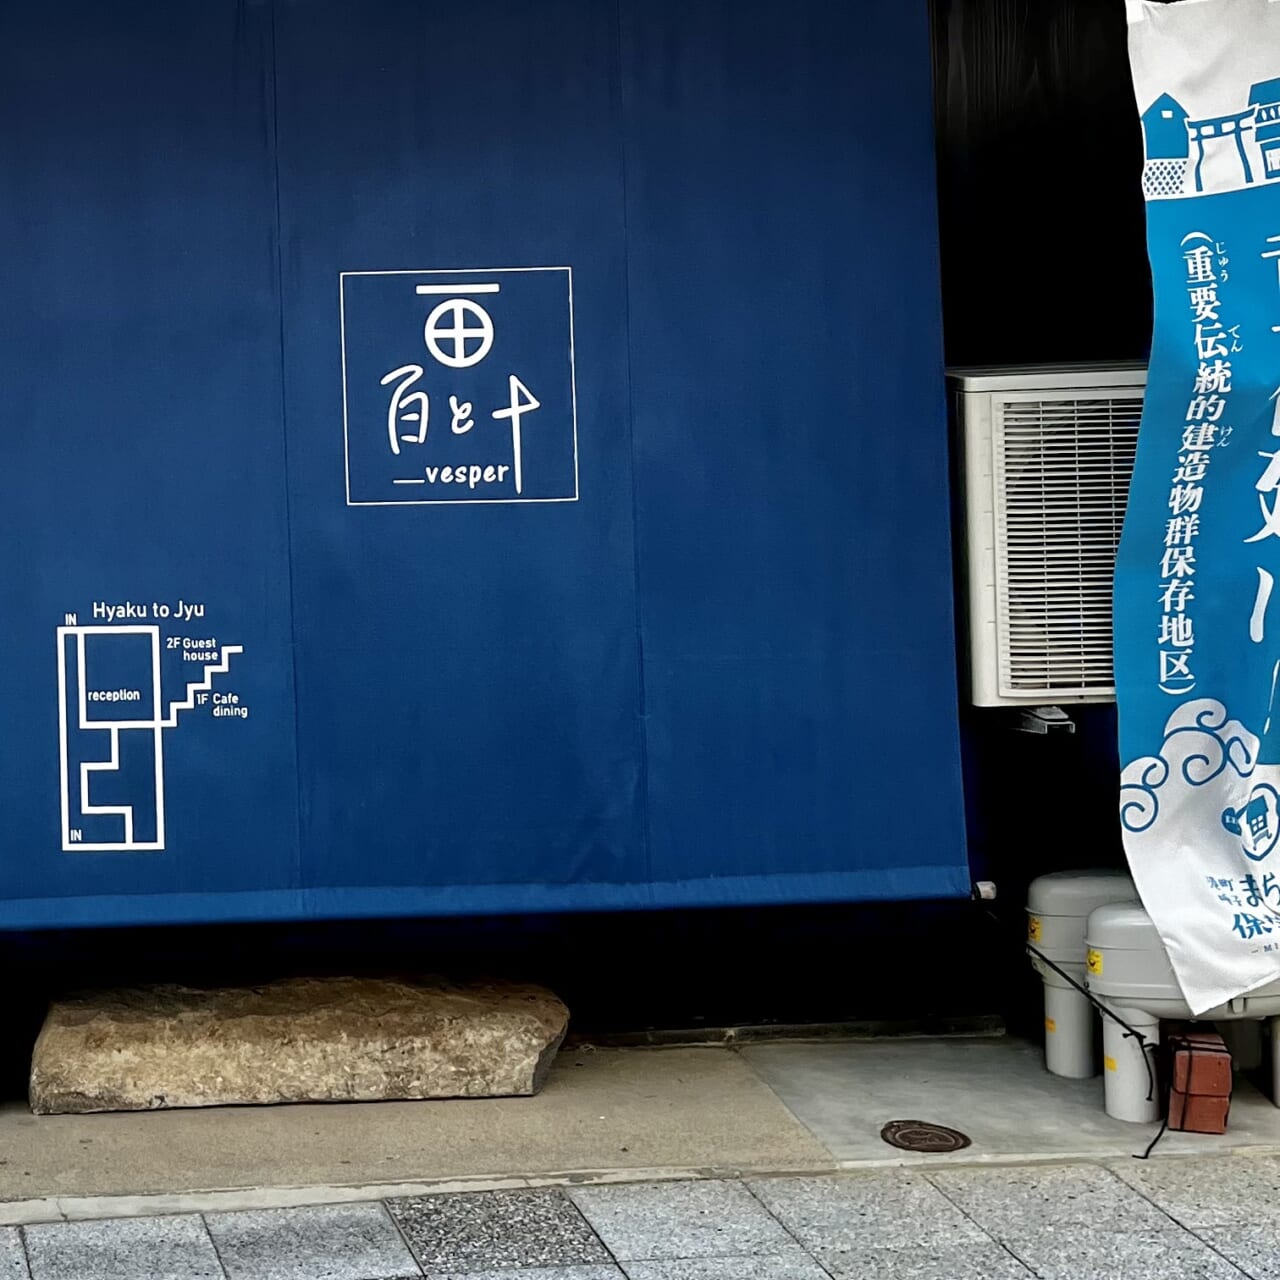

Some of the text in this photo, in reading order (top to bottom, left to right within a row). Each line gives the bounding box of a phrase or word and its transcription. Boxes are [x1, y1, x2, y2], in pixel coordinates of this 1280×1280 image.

[1215, 241, 1229, 283] じゅう
[1227, 324, 1243, 353] てん
[92, 600, 205, 622] Hyaku to Jyu
[64, 613, 77, 626] IN
[166, 637, 217, 649] 2F Guest
[183, 650, 219, 661] house
[87, 689, 141, 702] reception
[196, 692, 239, 705] 1F Cafe
[212, 705, 249, 719] dining
[70, 829, 82, 841] IN
